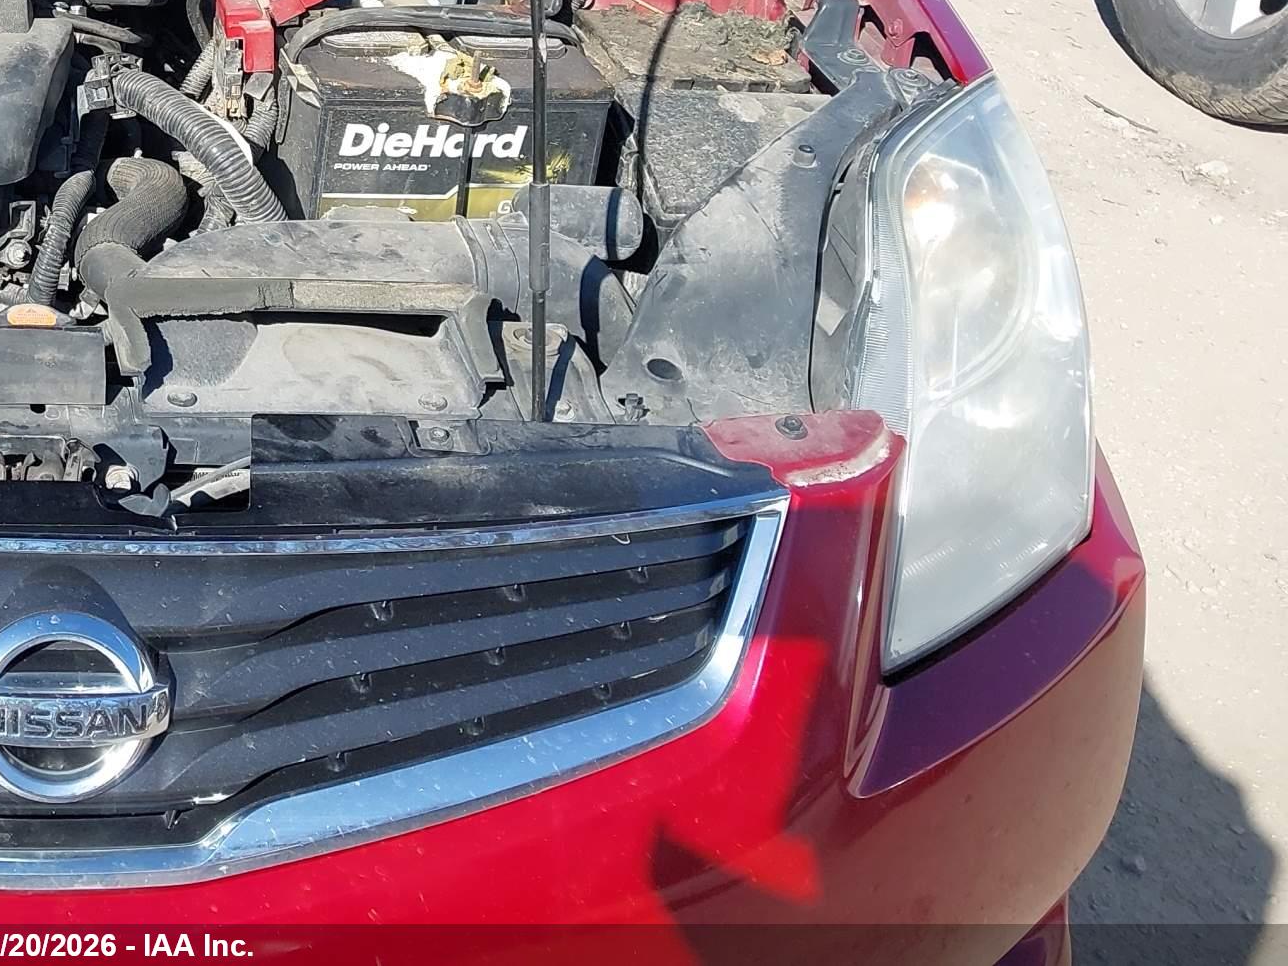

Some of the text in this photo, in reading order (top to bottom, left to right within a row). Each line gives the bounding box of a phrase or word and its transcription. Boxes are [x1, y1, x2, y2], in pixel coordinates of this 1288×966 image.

[338, 122, 529, 158] DieHard
[334, 163, 429, 171] POWER AHEAD
